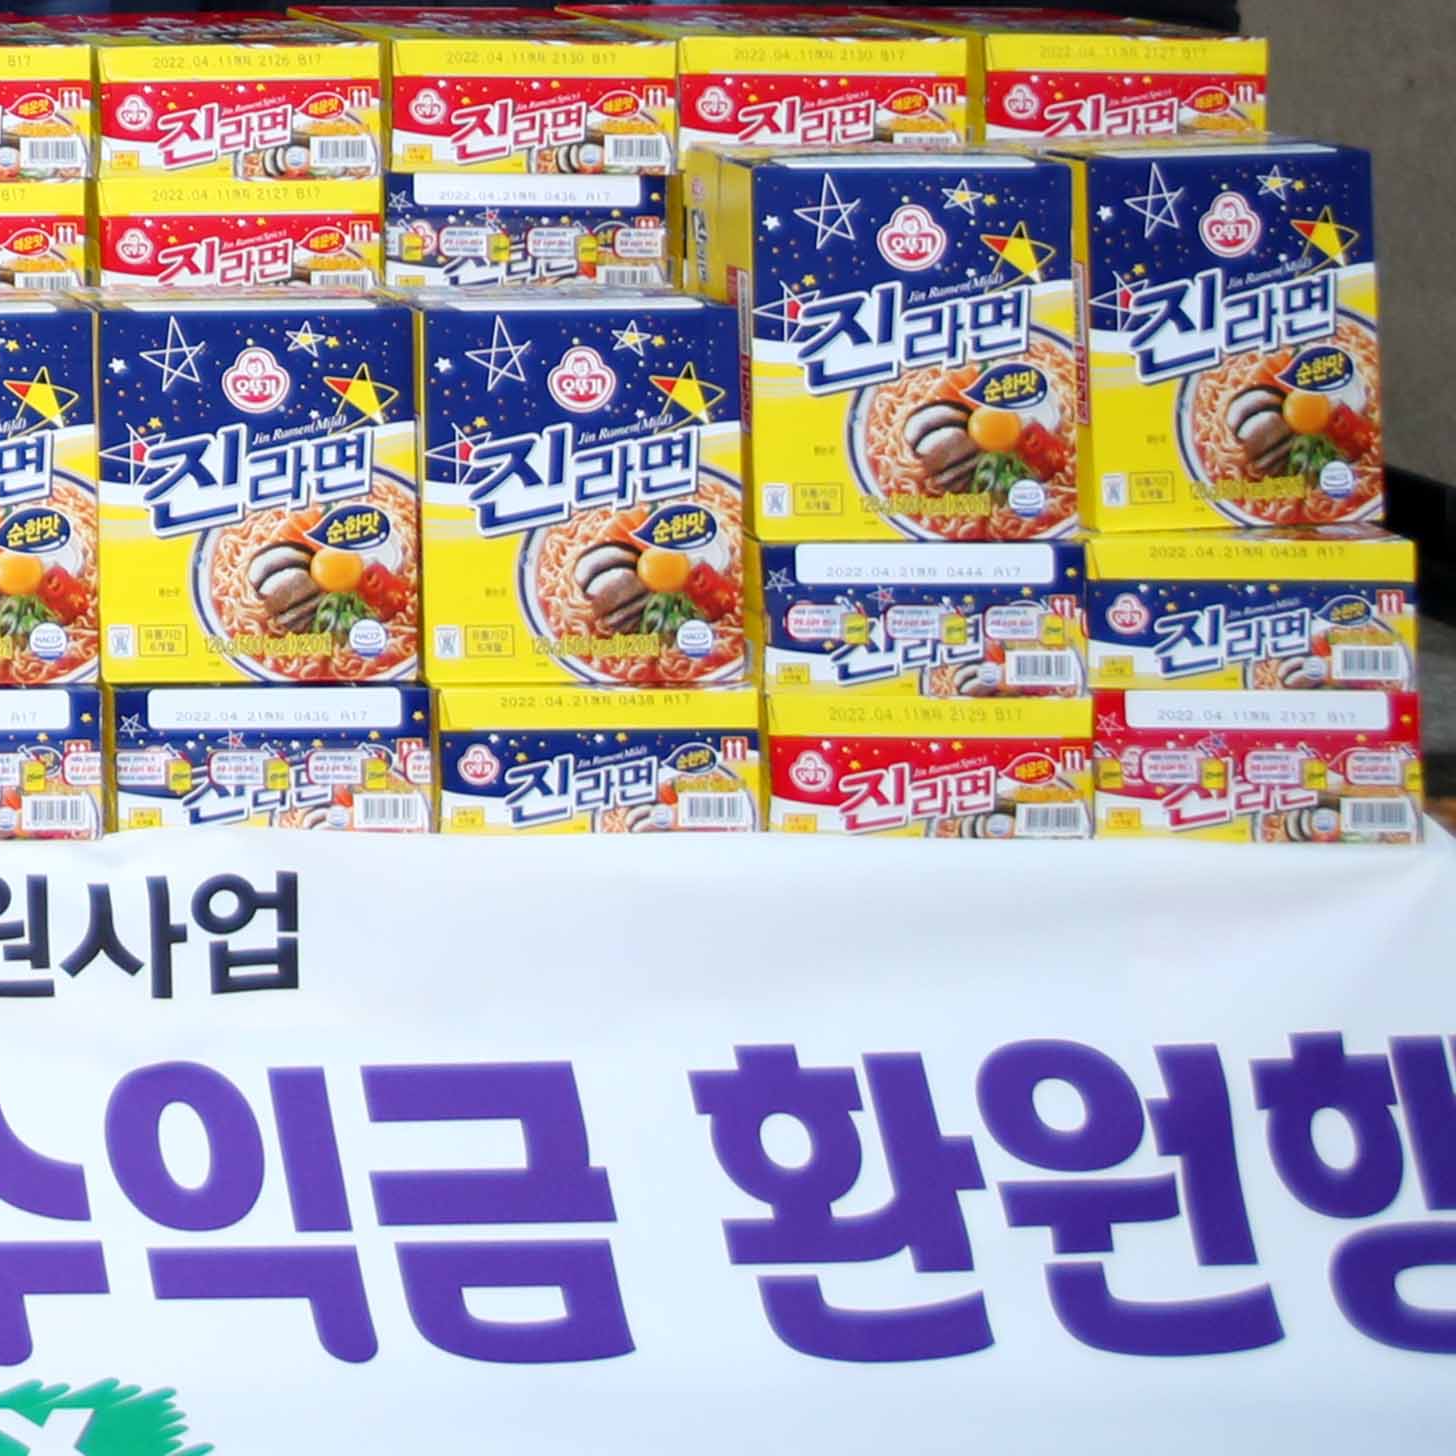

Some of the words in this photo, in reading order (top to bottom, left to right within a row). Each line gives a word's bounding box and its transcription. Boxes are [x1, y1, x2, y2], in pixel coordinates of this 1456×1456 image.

[158, 103, 292, 170] 진라면
[451, 99, 586, 167] 진라면
[890, 237, 932, 254] 오뚜기
[1210, 224, 1250, 240] 오뚜기
[907, 286, 926, 303] Jin
[1226, 273, 1244, 289] Jin
[798, 281, 1032, 397] 진라면
[1127, 272, 1340, 378] 진라면
[1294, 352, 1345, 383] 순한맛
[235, 379, 277, 396] 오뚜기
[560, 378, 602, 395] 오뚜기
[983, 370, 1038, 402] 순한맛
[251, 428, 271, 446] Jin
[577, 427, 597, 444] Jin
[145, 424, 374, 538] 진라면
[469, 423, 700, 538] 진라면
[6, 514, 61, 546] 순한맛
[326, 511, 381, 543] 순한맛
[652, 510, 708, 542] 순한맛
[1156, 604, 1309, 676] 진라면
[506, 754, 657, 828] 진라면
[840, 763, 996, 834] 진라면
